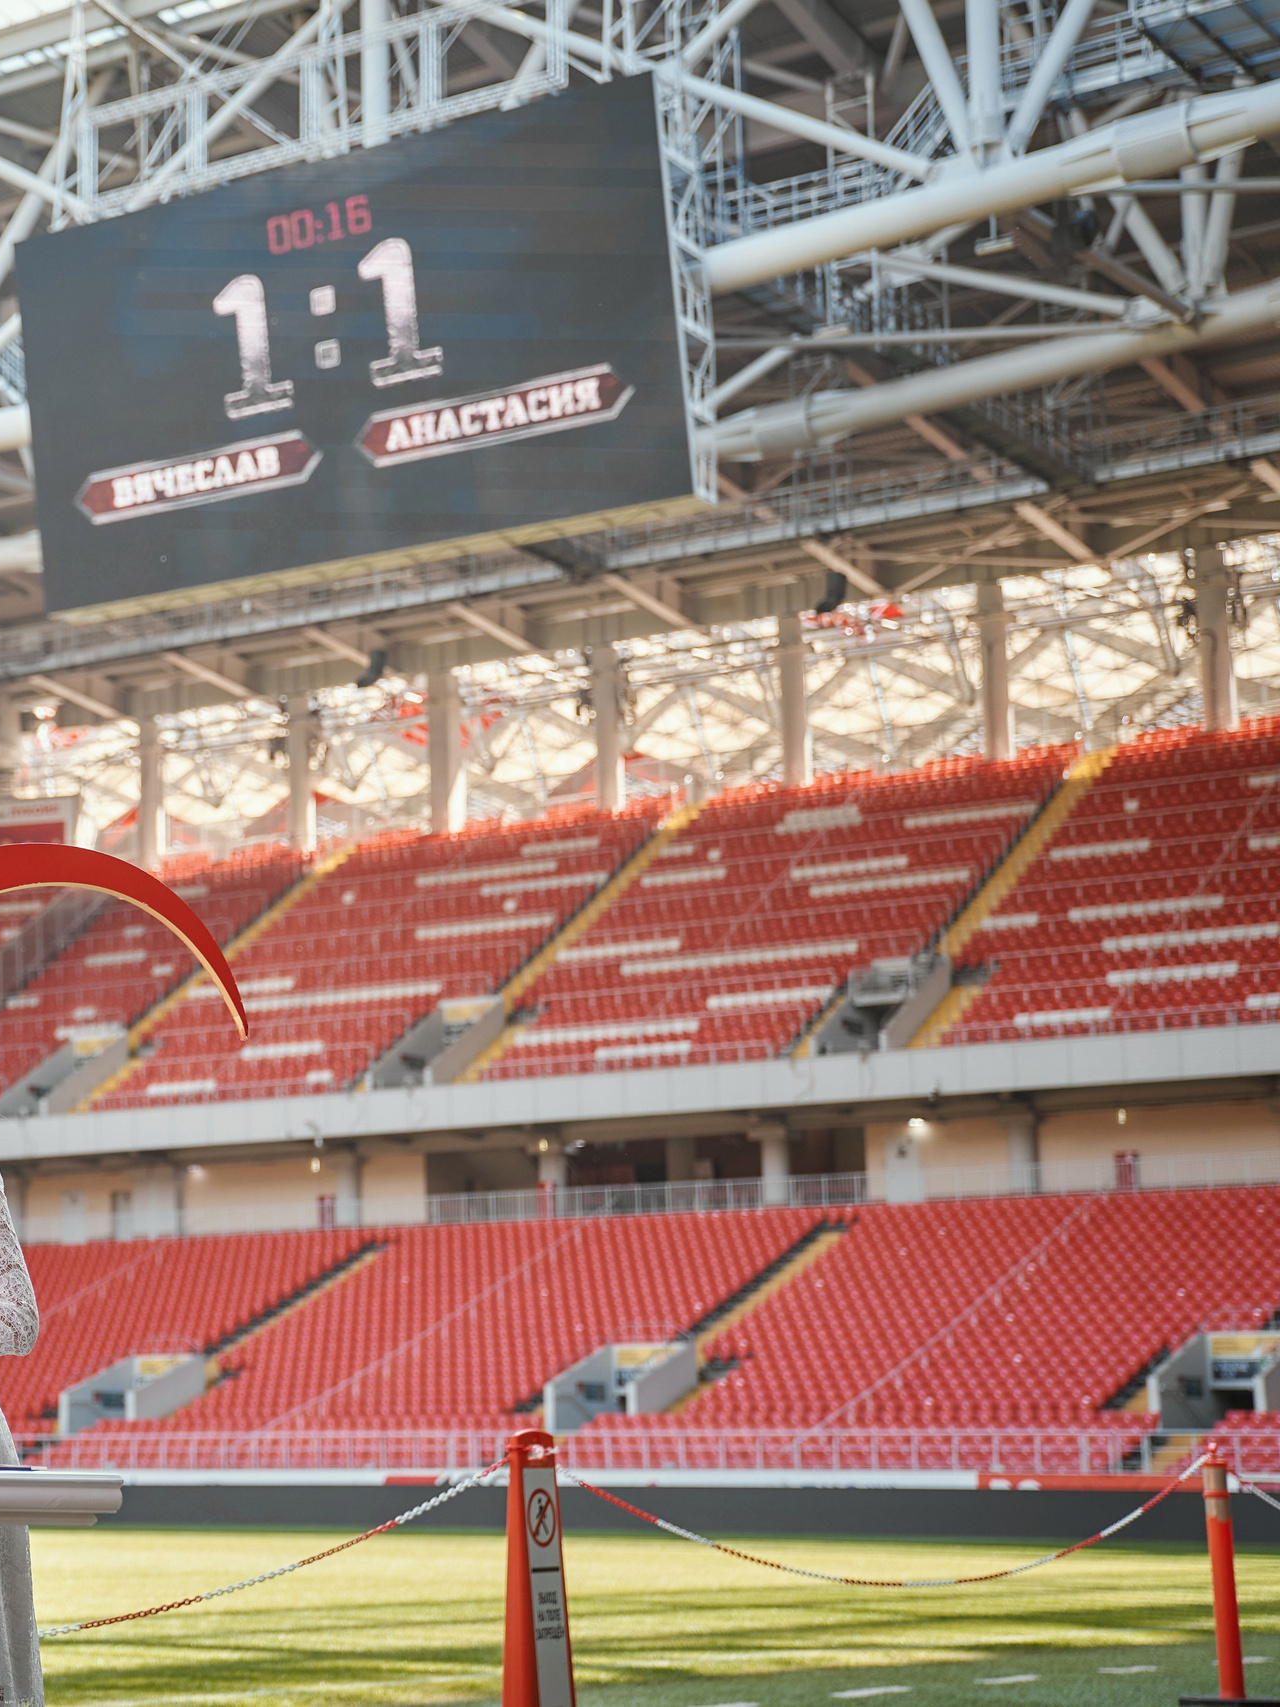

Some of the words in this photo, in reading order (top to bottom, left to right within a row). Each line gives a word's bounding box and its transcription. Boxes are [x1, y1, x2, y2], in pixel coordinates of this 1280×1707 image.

[266, 194, 373, 255] 00:16
[385, 377, 602, 452] АНАСТАСИЯ
[111, 446, 281, 509] ВЯЧЕСЛАВ
